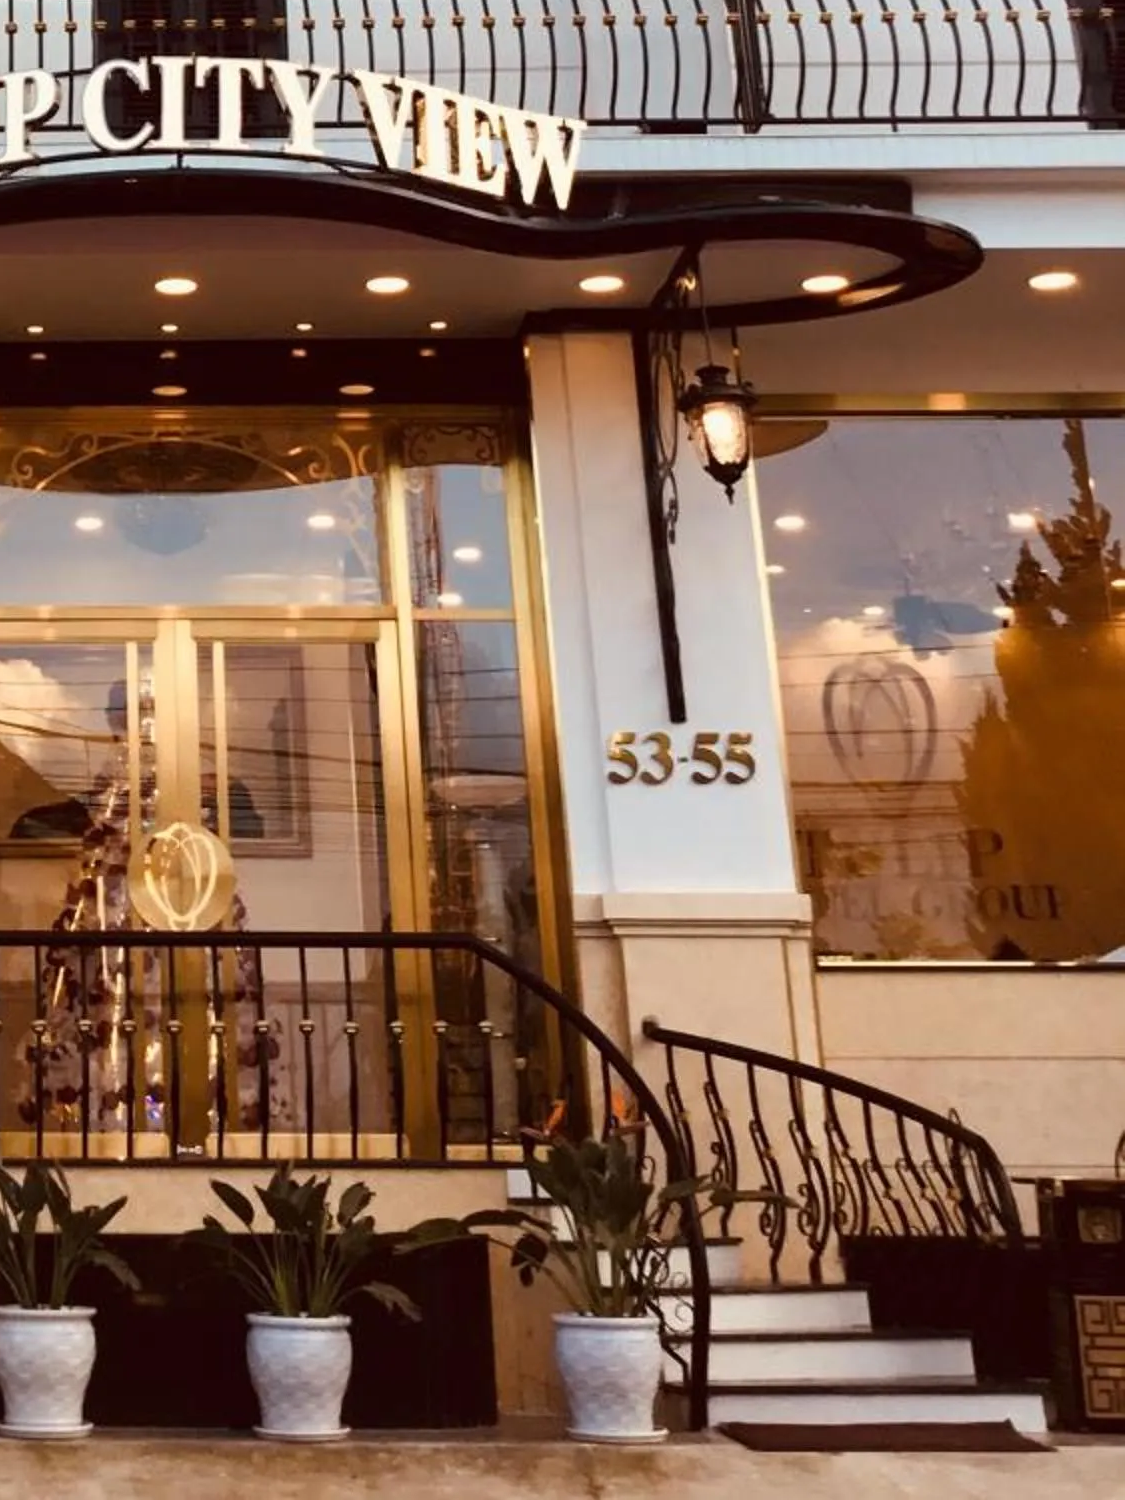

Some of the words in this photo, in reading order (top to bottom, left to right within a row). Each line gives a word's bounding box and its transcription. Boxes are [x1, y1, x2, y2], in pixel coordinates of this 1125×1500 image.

[82, 55, 335, 153] CITY
[349, 69, 588, 211] VIEW
[608, 731, 756, 785] 53-55
